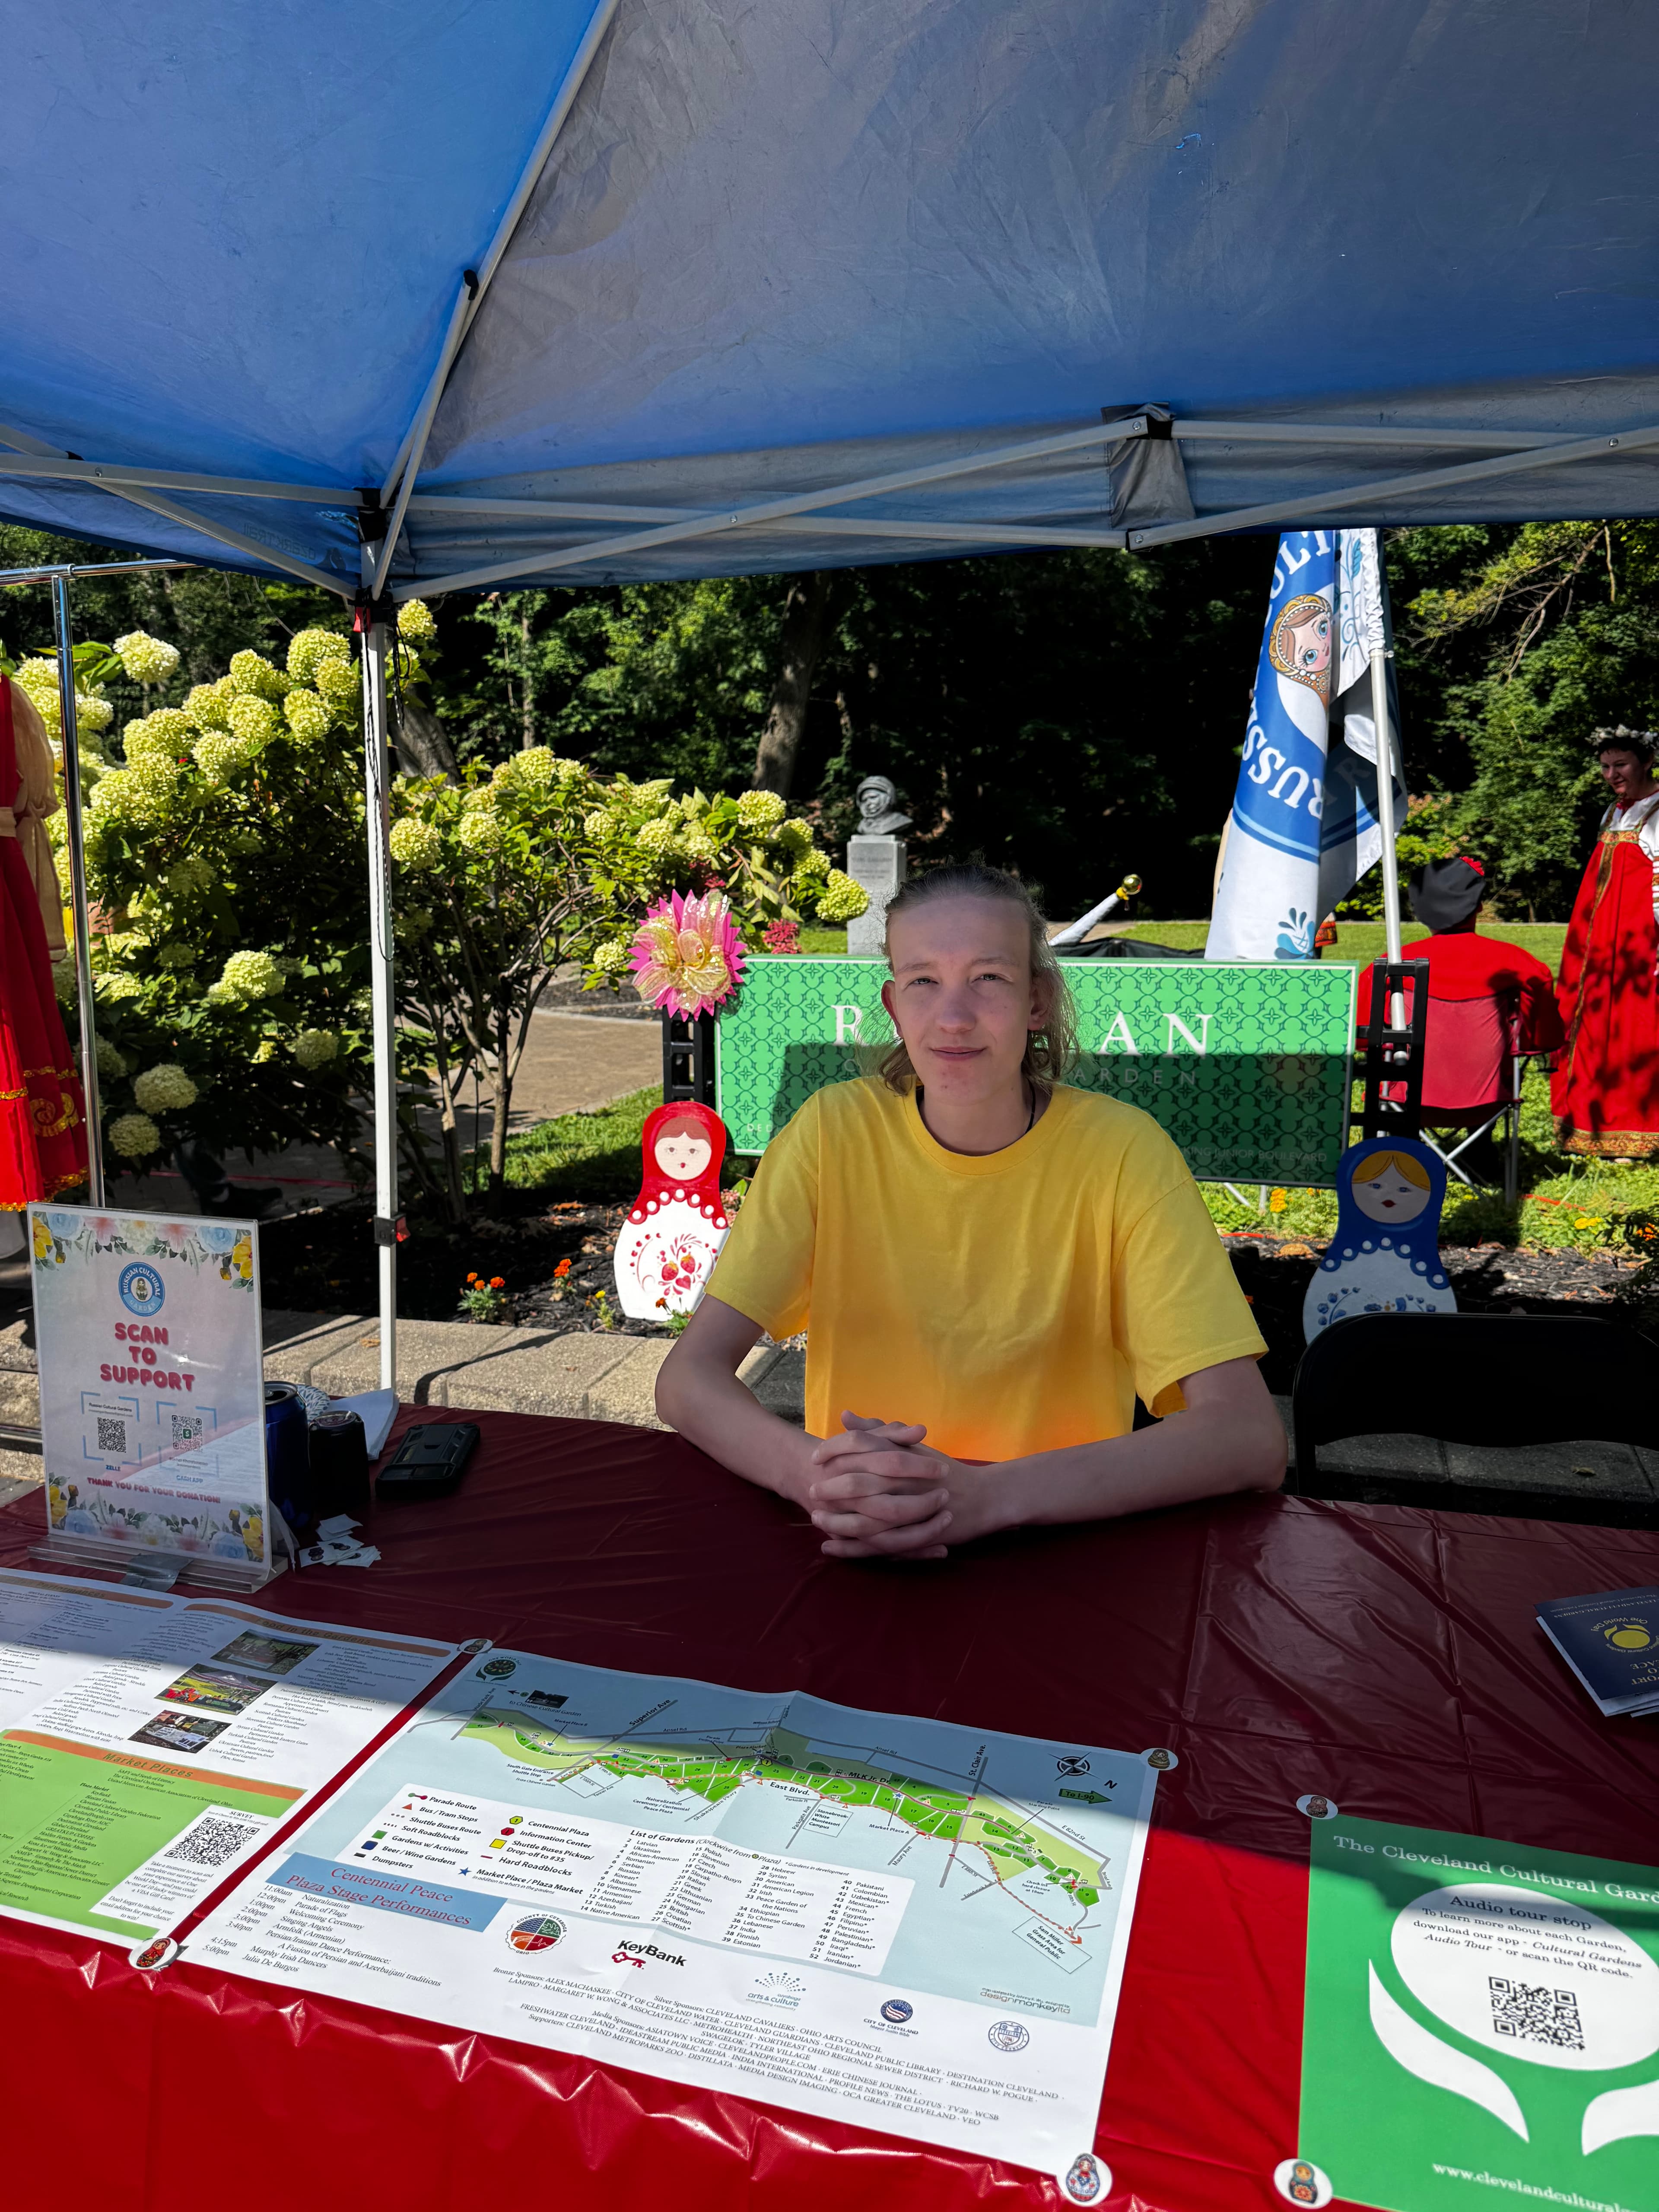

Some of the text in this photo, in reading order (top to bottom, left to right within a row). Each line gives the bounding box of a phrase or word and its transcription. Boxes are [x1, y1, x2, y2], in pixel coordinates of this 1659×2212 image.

[1074, 1068, 1196, 1085] ARDEN
[1183, 1146, 1327, 1162] KING JUNIOR BOULEVARD
[123, 1267, 161, 1296] RUSSIAN CULTURAL
[115, 1322, 168, 1345] SCAN
[129, 1346, 157, 1365] TO
[100, 1363, 195, 1392] SUPPORT
[87, 1477, 221, 1504] THANK YOU FOR YOUR DONATION!
[1591, 1623, 1605, 1632] Day
[629, 1699, 671, 1726] Superior Ave
[102, 1753, 193, 1777] Market Places
[972, 1755, 982, 1768] Clair
[978, 1744, 987, 1755] Ave.
[849, 1772, 868, 1780] MLK
[770, 1782, 810, 1796] East Blvd.
[429, 1796, 477, 1810] Parade Route
[229, 1811, 254, 1819] SURVEY
[811, 1817, 841, 1827] Montessori
[817, 1809, 849, 1818] Stonebrook-
[400, 1825, 461, 1841] Soft Roadblocks
[409, 1817, 481, 1835] Shuttle Buses Route
[528, 1821, 589, 1837] Centennial Plaza
[809, 1822, 830, 1830] Campus
[391, 1835, 423, 1846] Gardens
[432, 1843, 469, 1855] Activities
[519, 1830, 592, 1848] Information Center
[629, 1829, 647, 1838] List
[658, 1835, 695, 1844] Gardens
[371, 1855, 413, 1869] Dumpsters
[498, 1856, 572, 1876] Hard Roadblocks
[617, 1866, 641, 1875] Russian
[771, 1866, 796, 1875] Hebrew
[1333, 1835, 1375, 1854] The
[1382, 1845, 1494, 1875] Cleveland
[1500, 1864, 1599, 1894] Cultural
[331, 1867, 453, 1902] Centennial Peace
[607, 1883, 642, 1894] Vietnamese
[855, 1881, 884, 1891] Pakistani
[256, 1891, 286, 1904] 12:00pm
[294, 1901, 319, 1911] Parade
[327, 1908, 348, 1918] Flags
[264, 1885, 350, 1909] 11:00am Naturalization
[286, 1875, 472, 1926] Plaza Stage Performances
[597, 1895, 633, 1906] Azerbaijani
[249, 1898, 365, 1930] 1:00pm Welcoming Ceremony
[749, 1907, 780, 1917] Ethiopian
[1449, 1895, 1592, 1931] Audio tour stop
[1422, 1907, 1626, 1953] To learn more about each Garden,
[1413, 1920, 1642, 1968] download our app Cultural Gardens
[617, 1940, 687, 1967] KeyBank
[1423, 1933, 1461, 1945] Audio
[1464, 1939, 1492, 1951] Tour
[1522, 1952, 1550, 1962] scan
[1553, 1956, 1574, 1966] the
[1577, 1961, 1598, 1971] QR
[1601, 1967, 1632, 1978] code.
[653, 1995, 882, 2053] Silver Sponsors: CLEVELAND CAVALIERS OHIO ARTS COUNCIL
[887, 2024, 919, 2034] CLEVELAND
[700, 2030, 811, 2060] SWAGELOK TYLER VILLAGE
